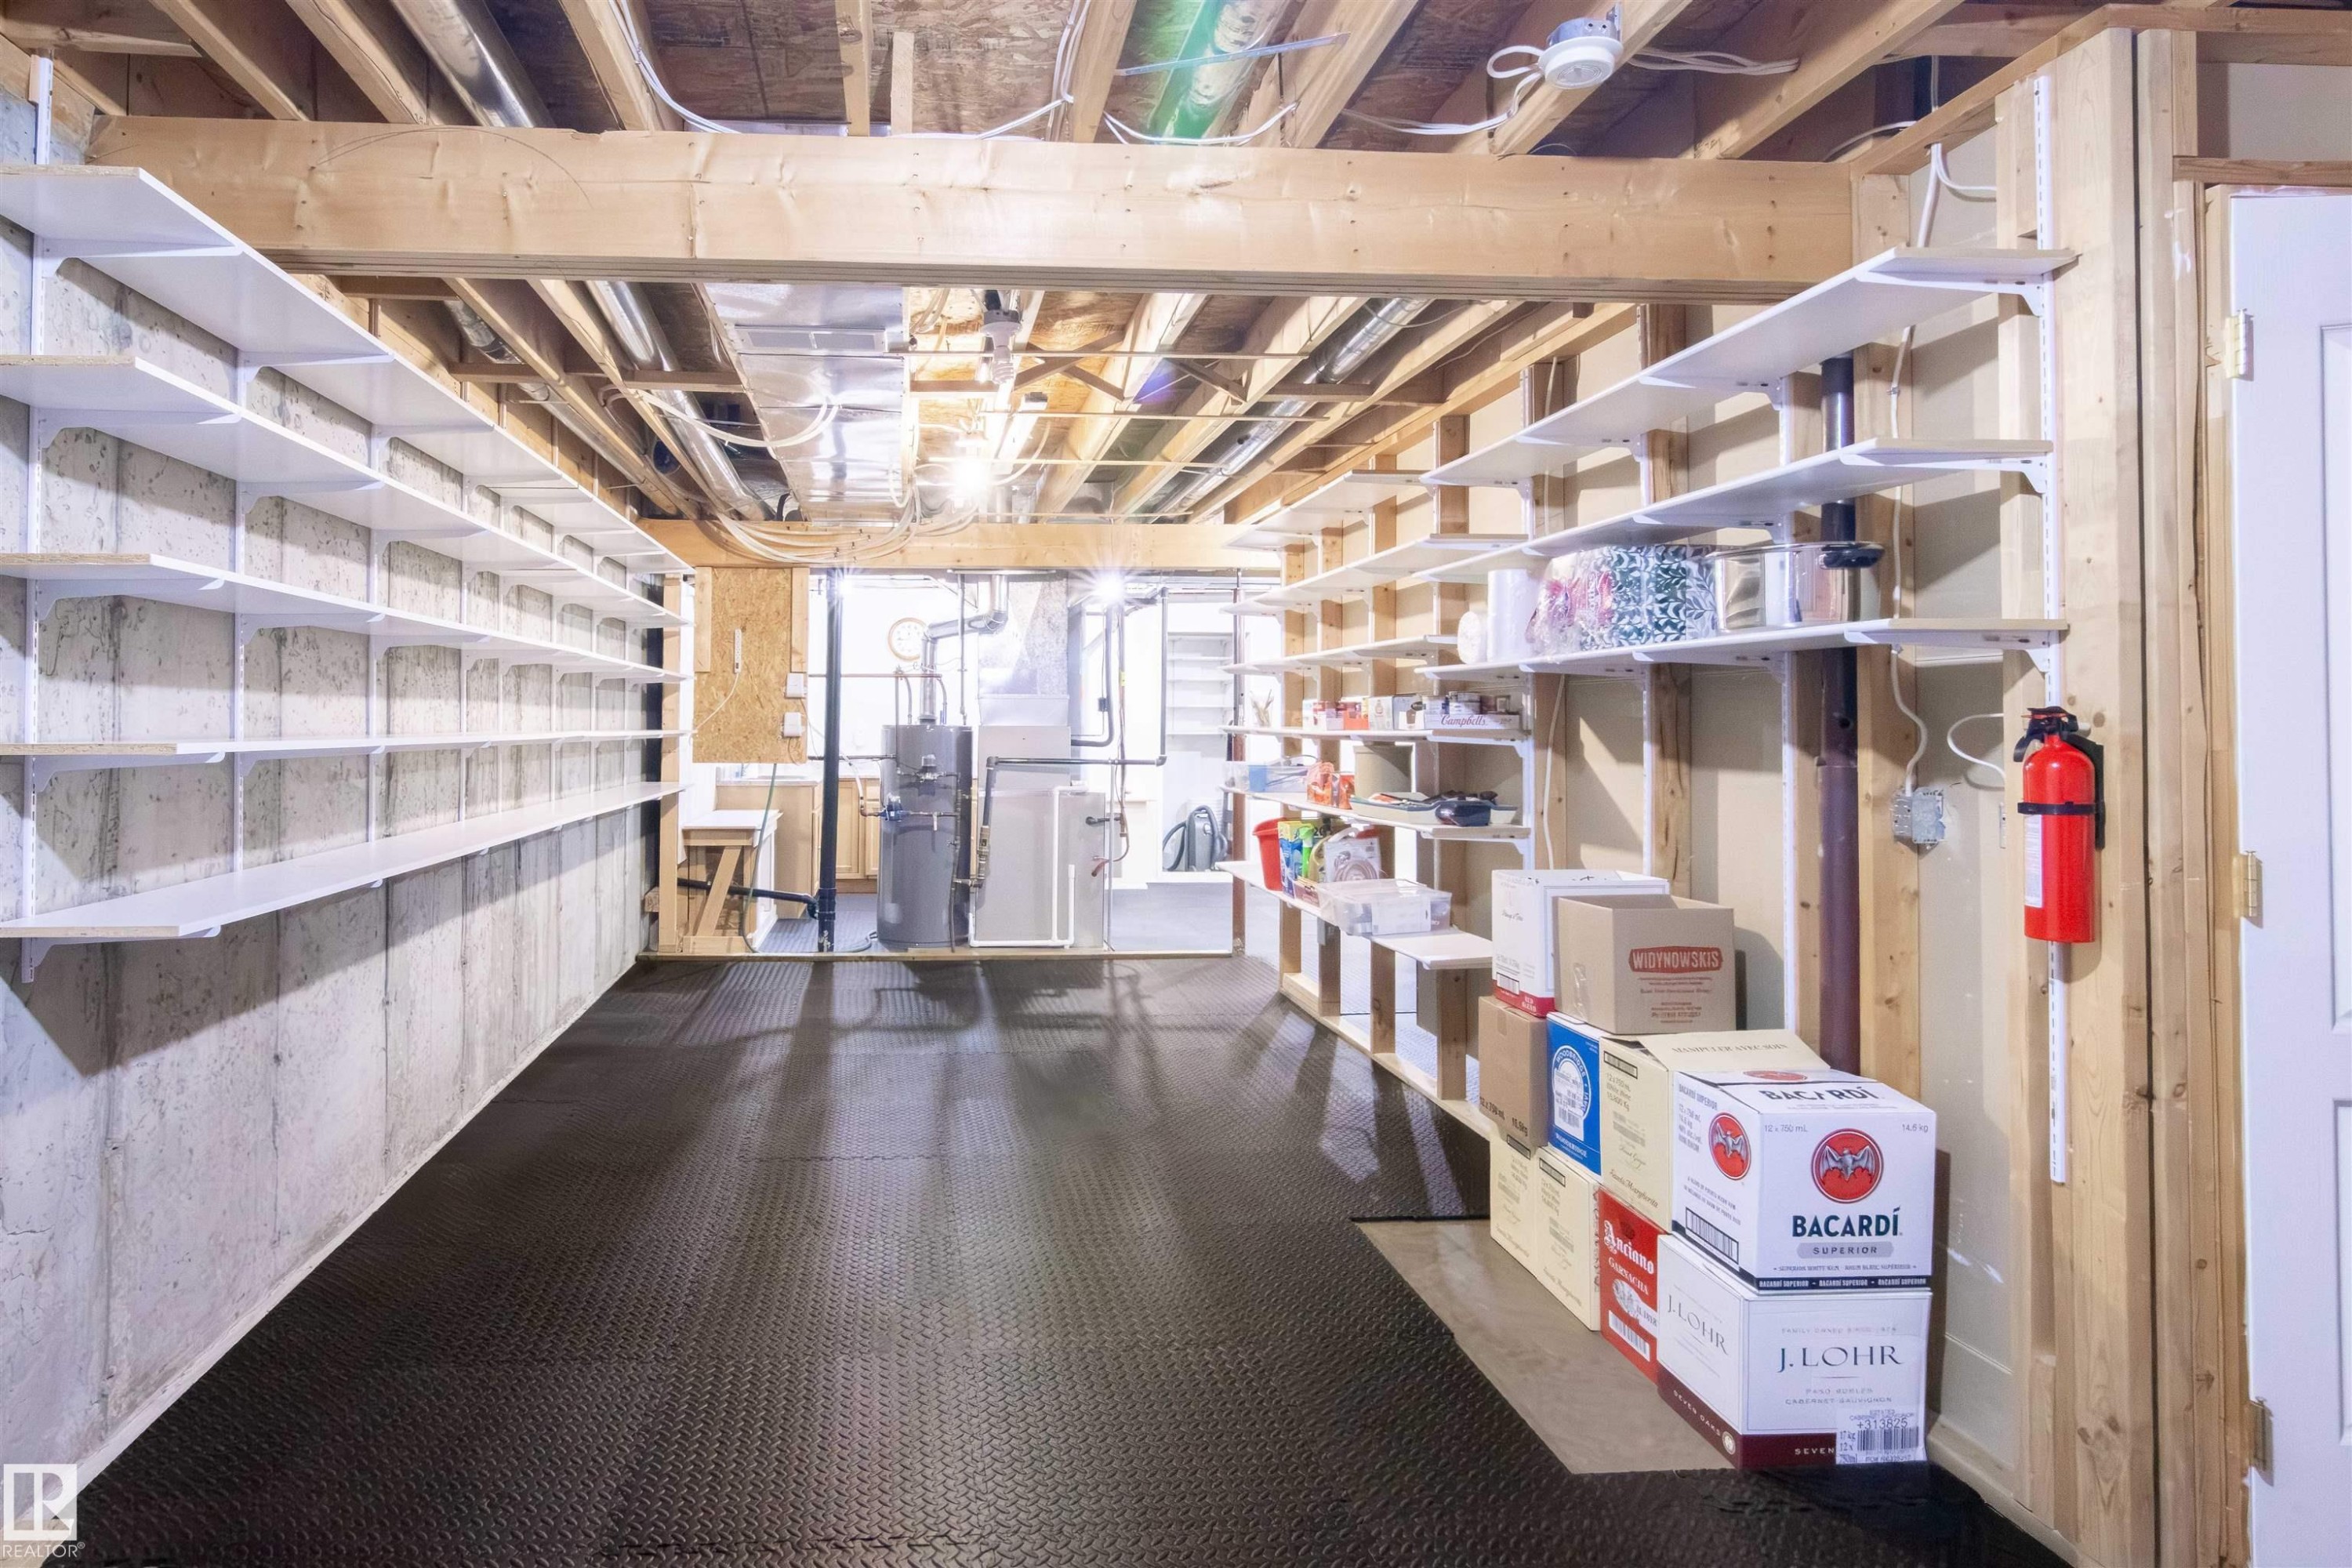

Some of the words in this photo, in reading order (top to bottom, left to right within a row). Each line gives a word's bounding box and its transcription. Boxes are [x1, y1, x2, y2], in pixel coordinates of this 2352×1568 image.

[1780, 1123, 1794, 1132] 750
[1919, 1123, 1929, 1133] kg
[1791, 1207, 1901, 1237] BACARDÍ
[1604, 1220, 1654, 1274] Anciano
[1812, 1246, 1878, 1255] SUPERIOR
[1679, 1302, 1730, 1356] LOHR
[1777, 1348, 1794, 1373] J.
[1802, 1345, 1905, 1367] LOHR
[1857, 1417, 1908, 1429] +313825
